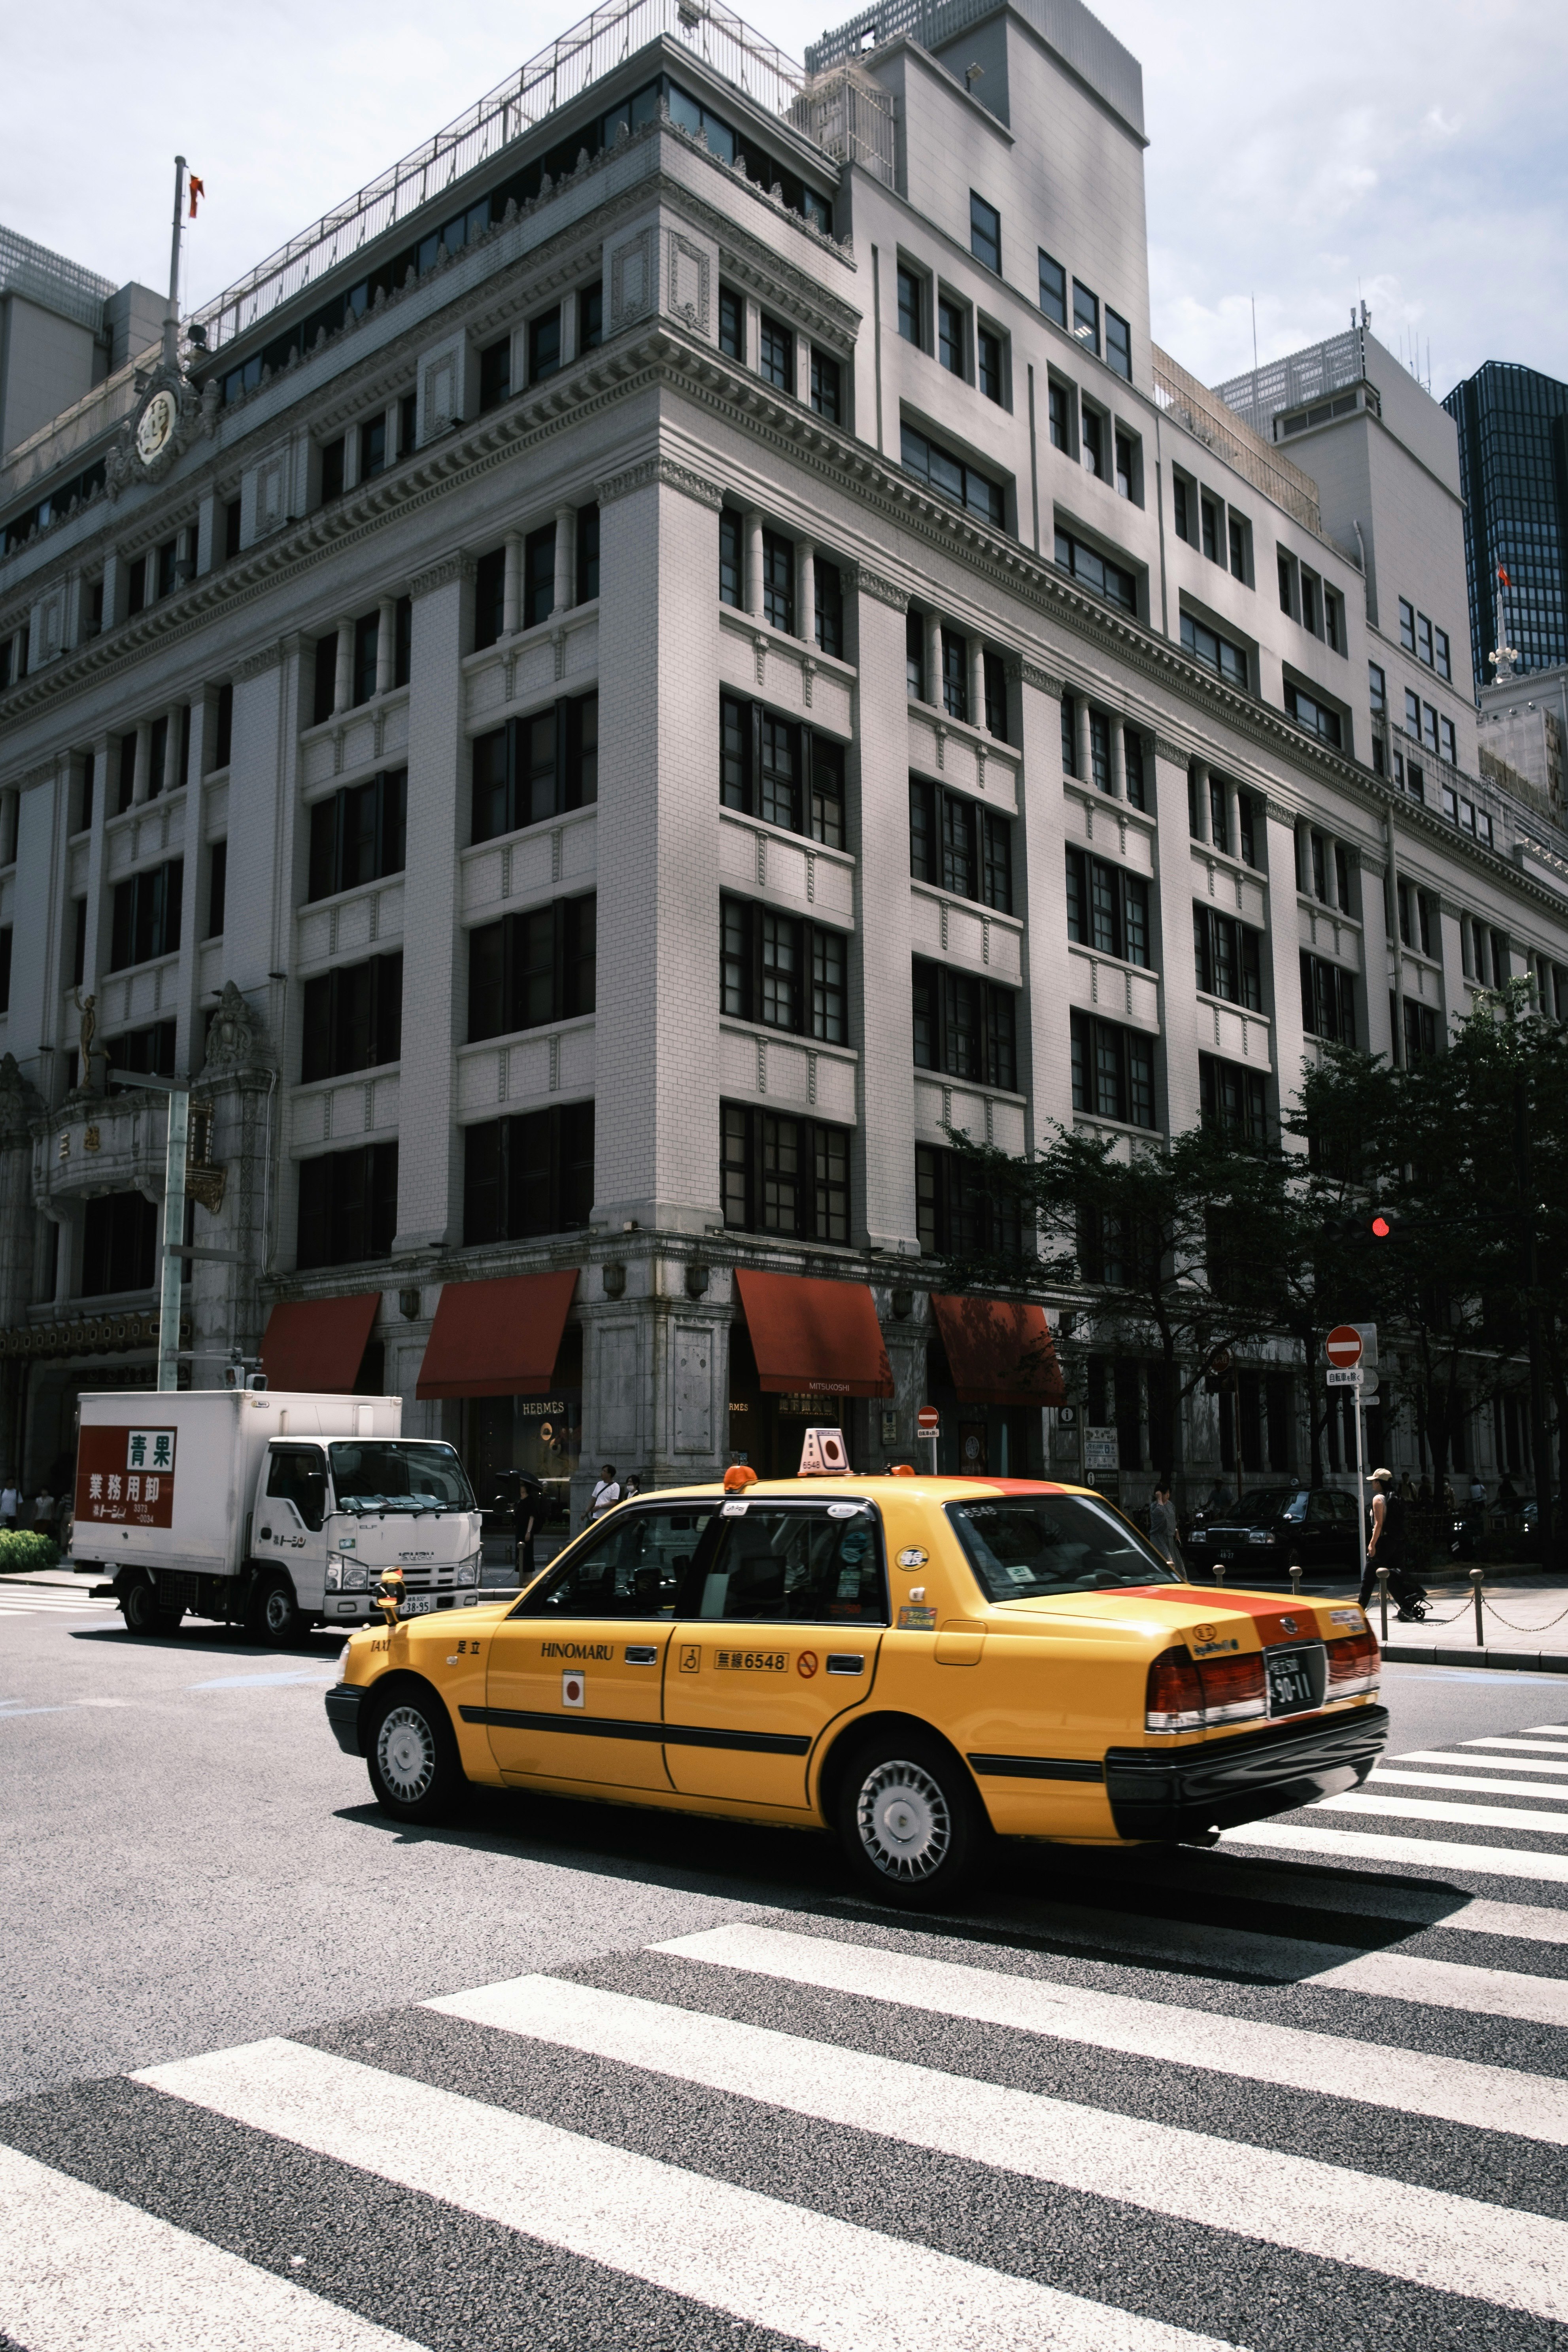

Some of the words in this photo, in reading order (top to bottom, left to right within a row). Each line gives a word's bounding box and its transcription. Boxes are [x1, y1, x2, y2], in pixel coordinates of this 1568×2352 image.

[1330, 1372, 1360, 1383] 自転車を除く
[809, 1383, 849, 1391] MITSUKOSHI
[131, 1435, 170, 1467] 青果
[89, 1473, 159, 1503] 業務用卸
[963, 1506, 997, 1517] 6548
[399, 1551, 434, 1560] ISUZU
[406, 1602, 429, 1612] 38-95
[371, 1639, 391, 1652] TAXI
[457, 1640, 480, 1654] 足立
[541, 1642, 614, 1660] HINOMARU
[1274, 1673, 1311, 1703] 90-11
